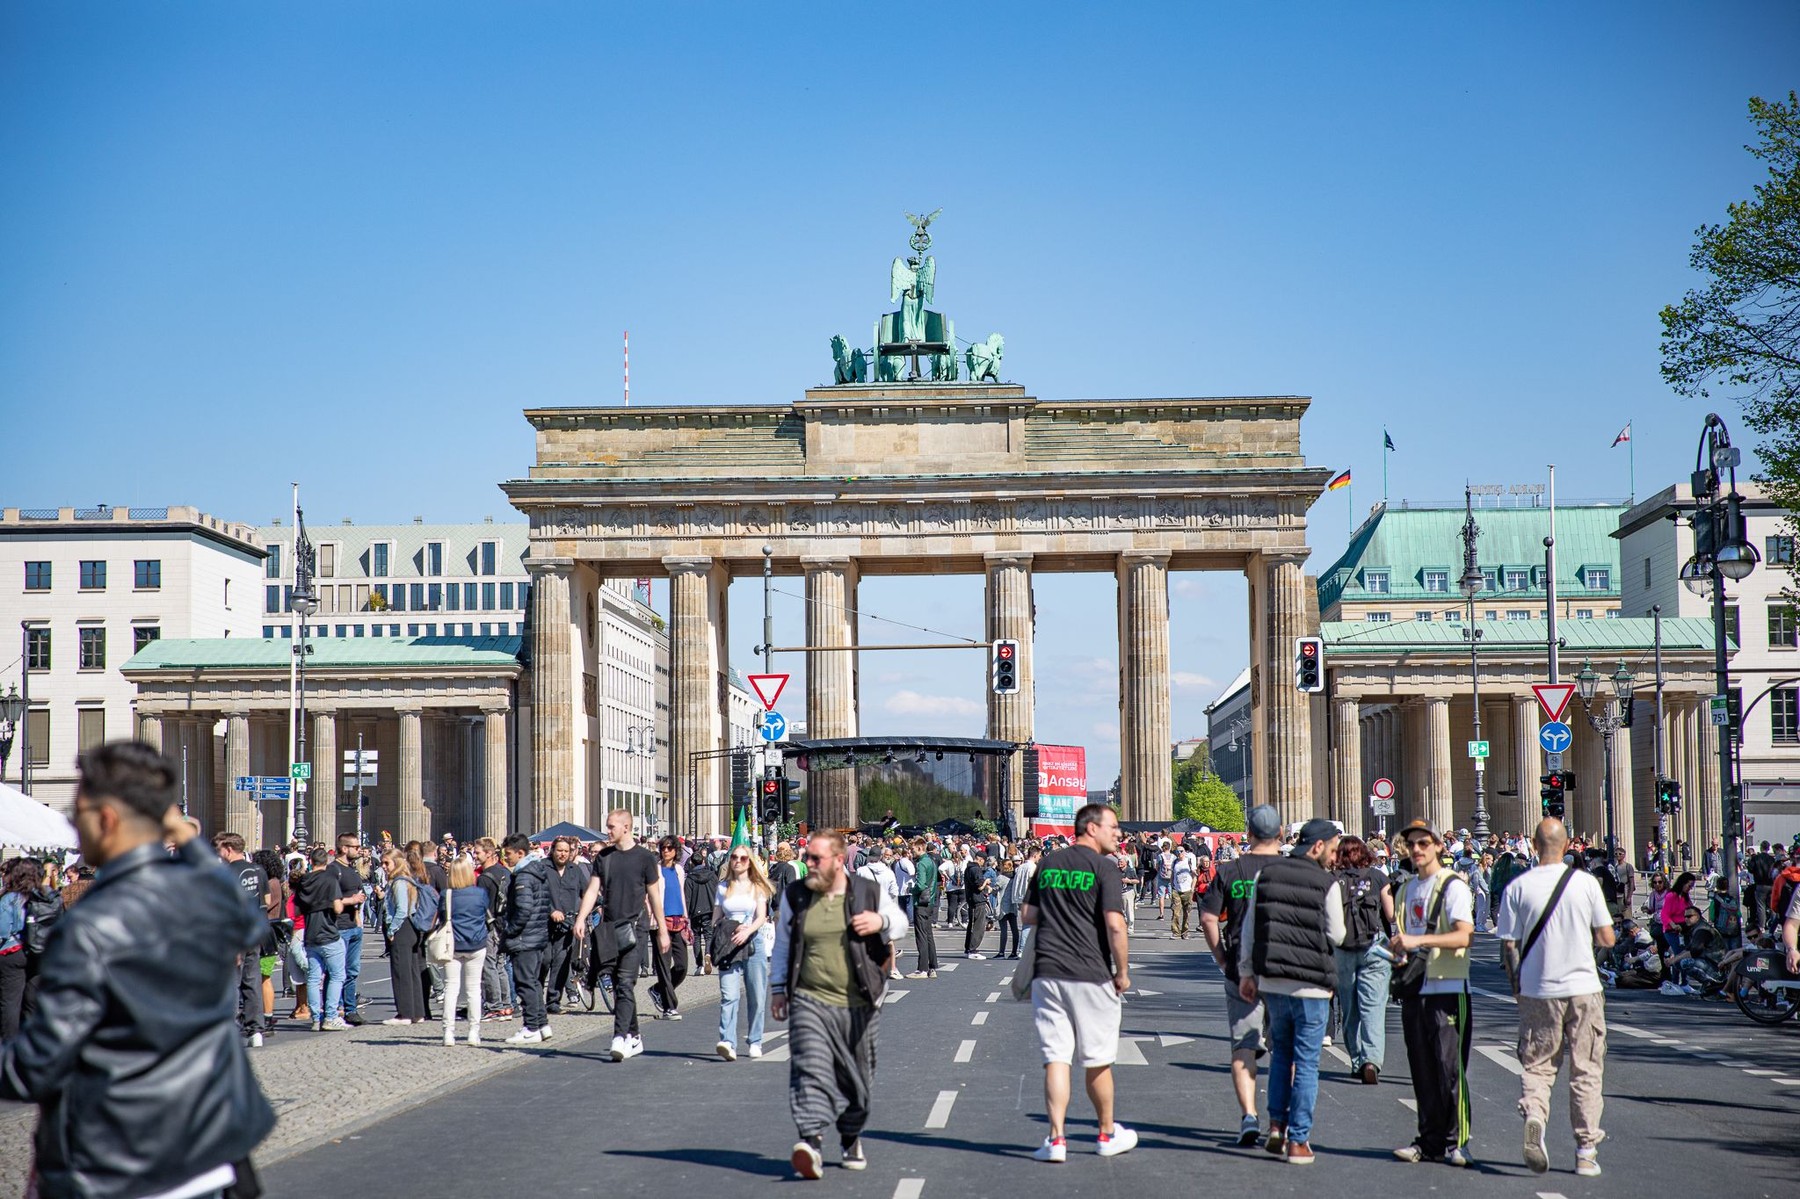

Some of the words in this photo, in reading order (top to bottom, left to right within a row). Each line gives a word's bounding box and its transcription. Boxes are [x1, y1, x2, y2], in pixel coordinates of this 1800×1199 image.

[1712, 713, 1727, 723] 751
[1048, 775, 1086, 790] Ansay
[1039, 869, 1095, 891] STAFF
[1231, 879, 1255, 898] ST
